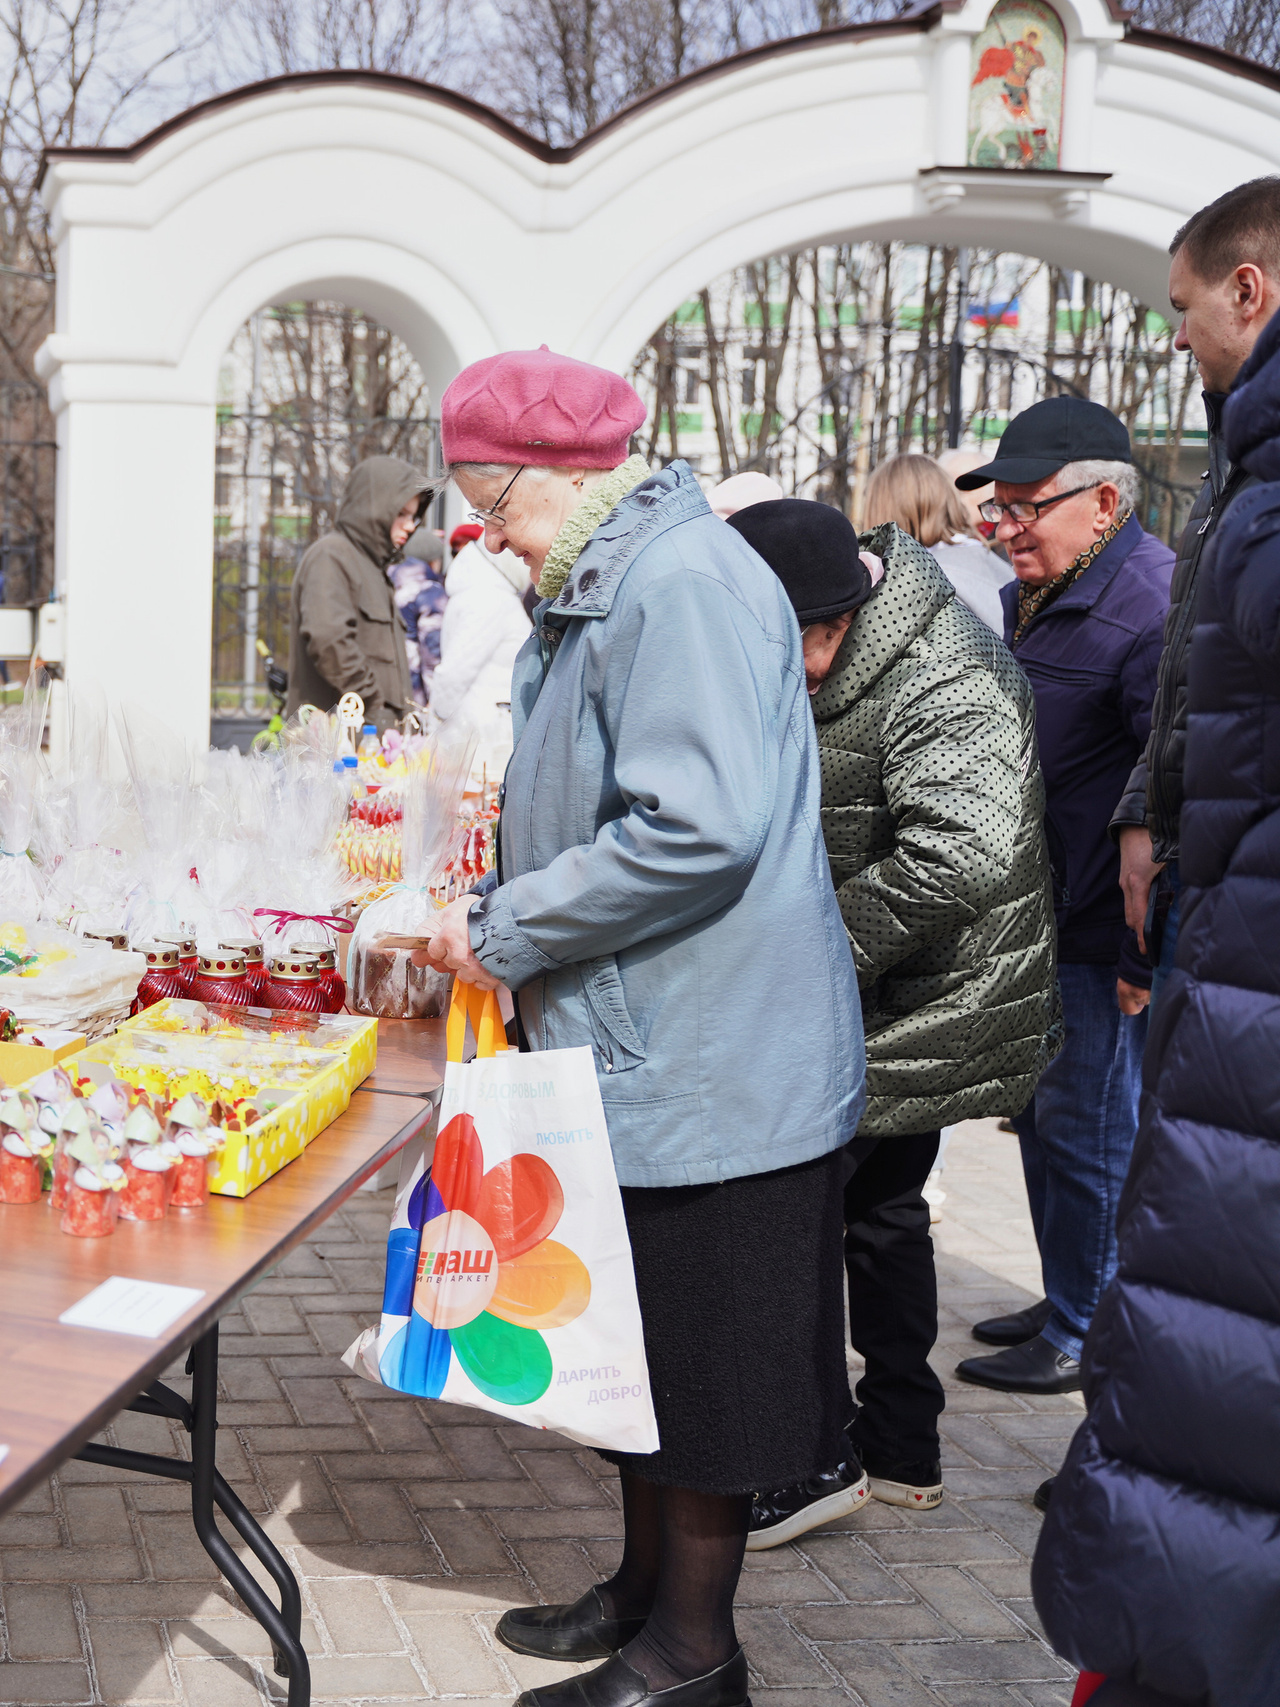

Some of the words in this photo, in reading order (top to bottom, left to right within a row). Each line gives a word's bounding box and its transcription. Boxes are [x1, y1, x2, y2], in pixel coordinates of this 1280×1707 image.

[536, 1127, 594, 1146] ЛЮБИТЬ
[556, 1365, 621, 1387] ДАРИТЬ
[587, 1384, 642, 1406] ДОБРО
